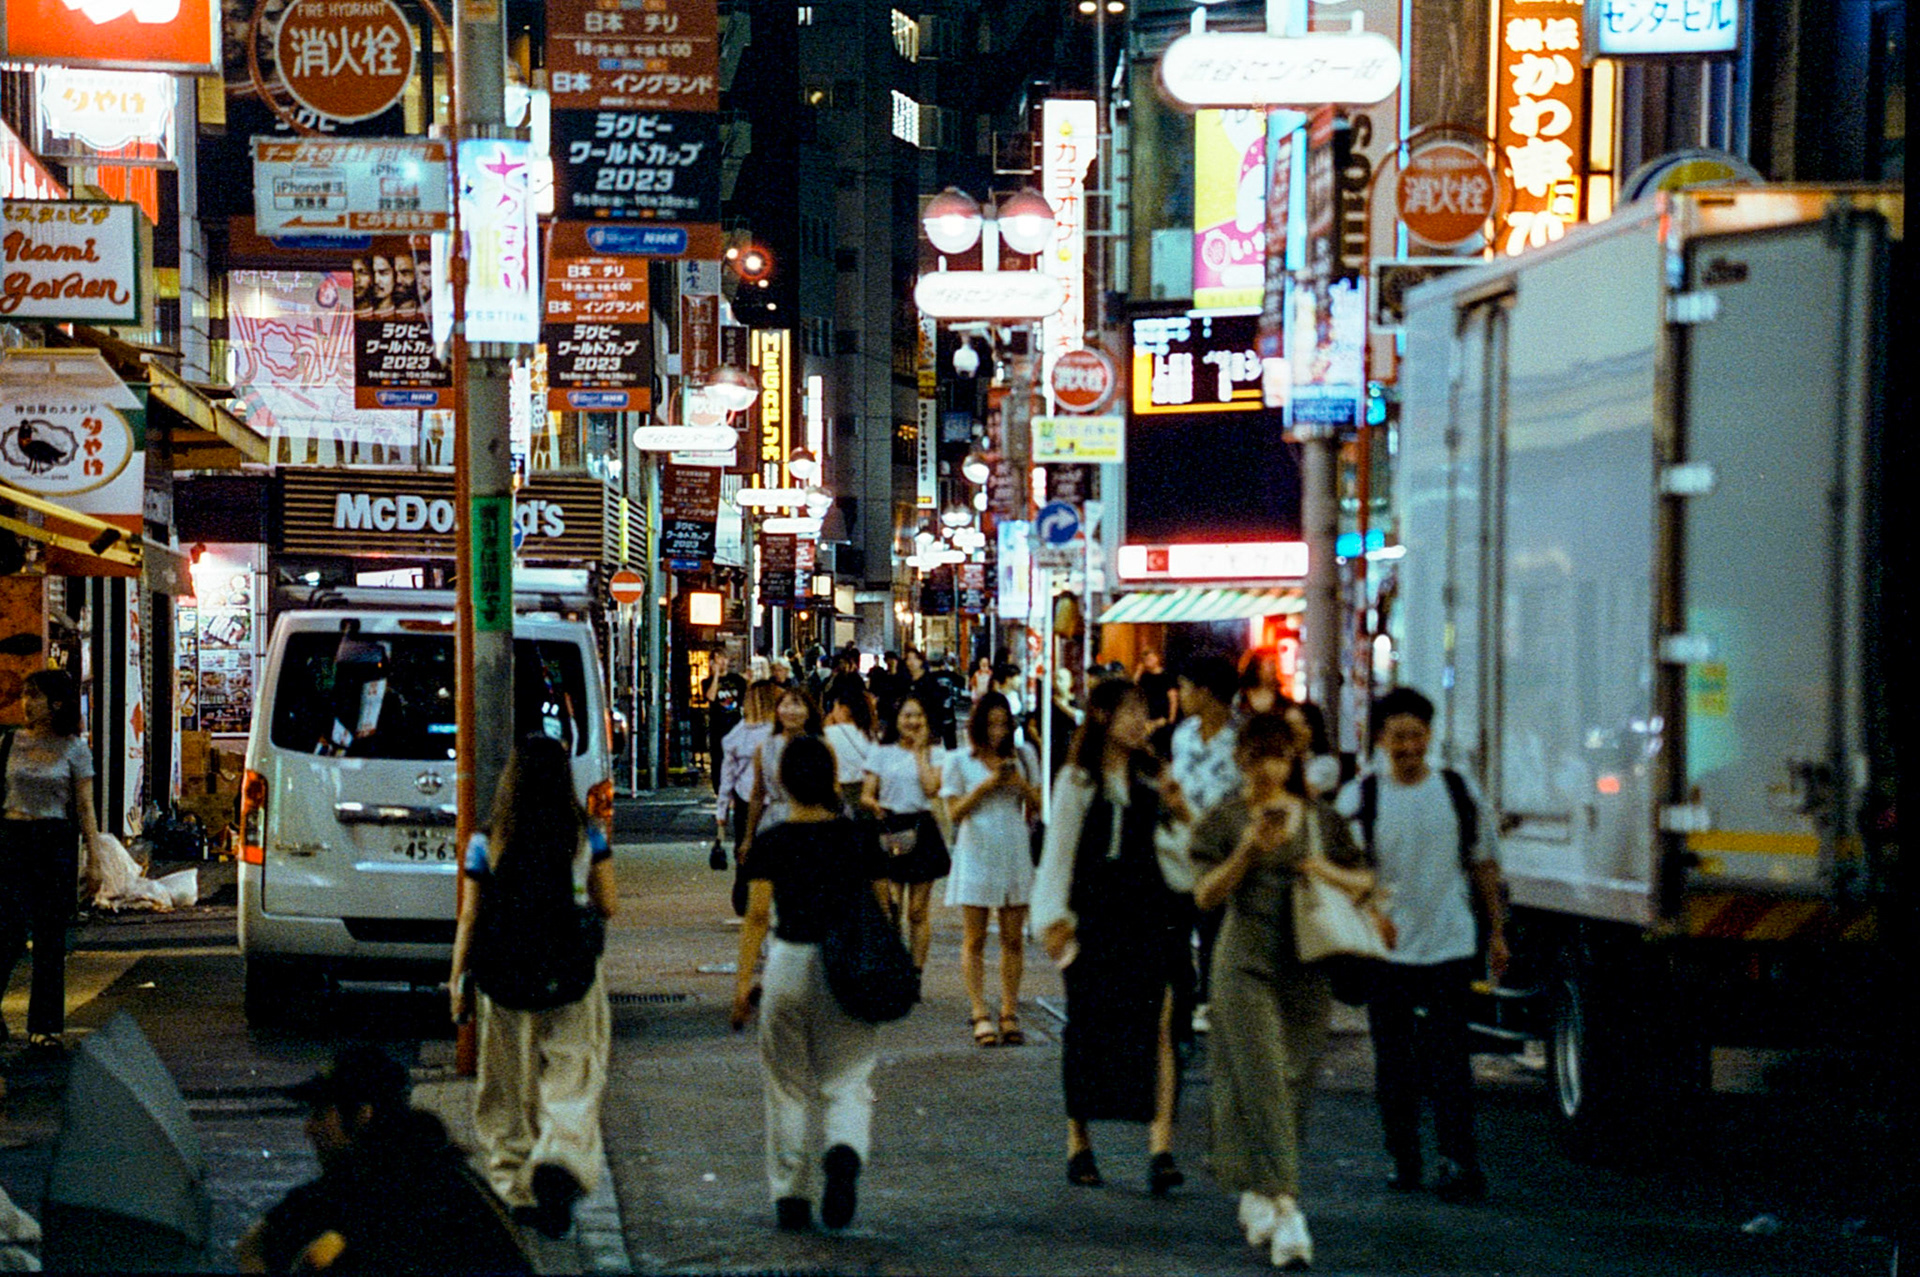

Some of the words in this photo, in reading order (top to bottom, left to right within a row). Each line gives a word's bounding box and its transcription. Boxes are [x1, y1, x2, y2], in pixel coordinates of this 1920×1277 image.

[298, 4, 325, 17] FIRE
[329, 3, 386, 17] HYDRANT
[1603, 1, 1731, 33] センタービル
[585, 11, 625, 32] 日本
[643, 13, 679, 33] チリ
[289, 25, 403, 77] 消火栓
[552, 71, 592, 93] 日本
[611, 73, 714, 95] イングランド
[595, 112, 674, 139] ラグビー
[568, 141, 704, 167] ワールドカップ
[595, 168, 675, 192] 2023
[1054, 143, 1079, 242] カラオケ
[1404, 174, 1488, 215] 消火栓
[643, 231, 679, 246] NHK
[567, 264, 592, 278] 日本
[603, 264, 625, 278] チリ
[548, 300, 572, 314] 日本
[583, 300, 645, 314] イングランド
[382, 322, 430, 339] ラグビー
[573, 325, 621, 340] ラグビー
[366, 340, 435, 354] ワールドカッ
[558, 339, 640, 355] ワールドカップ
[382, 355, 430, 370] 2023
[573, 357, 621, 371] 2023
[762, 332, 780, 461] MEGAドンキ
[332, 492, 566, 538] McDod's
